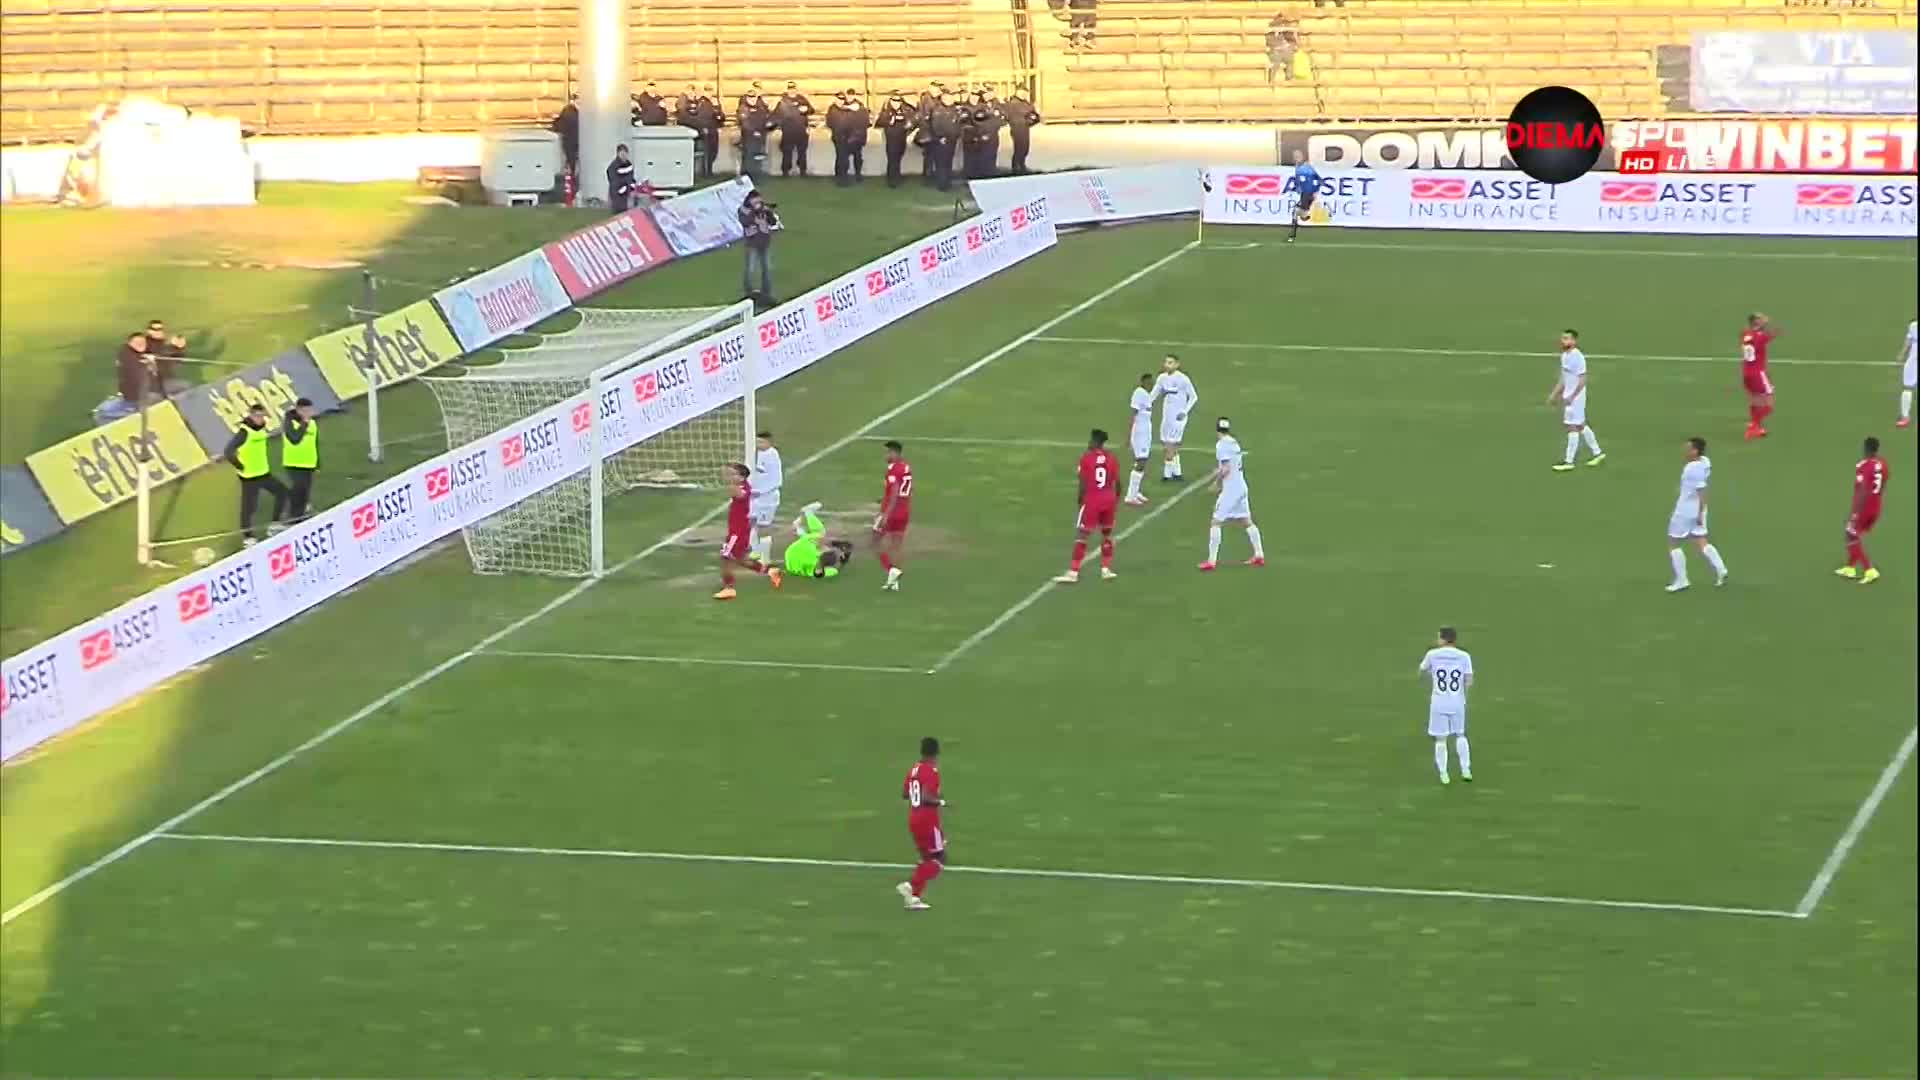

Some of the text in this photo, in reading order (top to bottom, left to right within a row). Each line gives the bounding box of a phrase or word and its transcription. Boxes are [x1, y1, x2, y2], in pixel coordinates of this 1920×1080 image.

[1281, 176, 1376, 196] ASET
[1468, 179, 1558, 200] ASSET
[1659, 182, 1756, 204] ASSET
[1856, 185, 1914, 206] ASS
[1224, 198, 1371, 217] INSURNCE
[1409, 202, 1558, 221] INSURANCE
[1597, 206, 1752, 225] INSURANCE
[558, 216, 653, 288] WINBET
[884, 258, 911, 288] ASSET
[831, 283, 858, 312] ASSET
[776, 307, 808, 339] ASSET
[719, 334, 744, 368] ASSE
[655, 358, 691, 395] ASSET
[523, 417, 559, 457] ASSET
[450, 450, 488, 492] ASSET
[1094, 466, 1107, 488] 9
[376, 483, 413, 526] ASSET
[294, 522, 336, 567] ASSET
[211, 563, 256, 608] ASSET
[114, 604, 159, 650] ASSET
[9, 653, 58, 705] ASSET
[1436, 669, 1462, 692] 88
